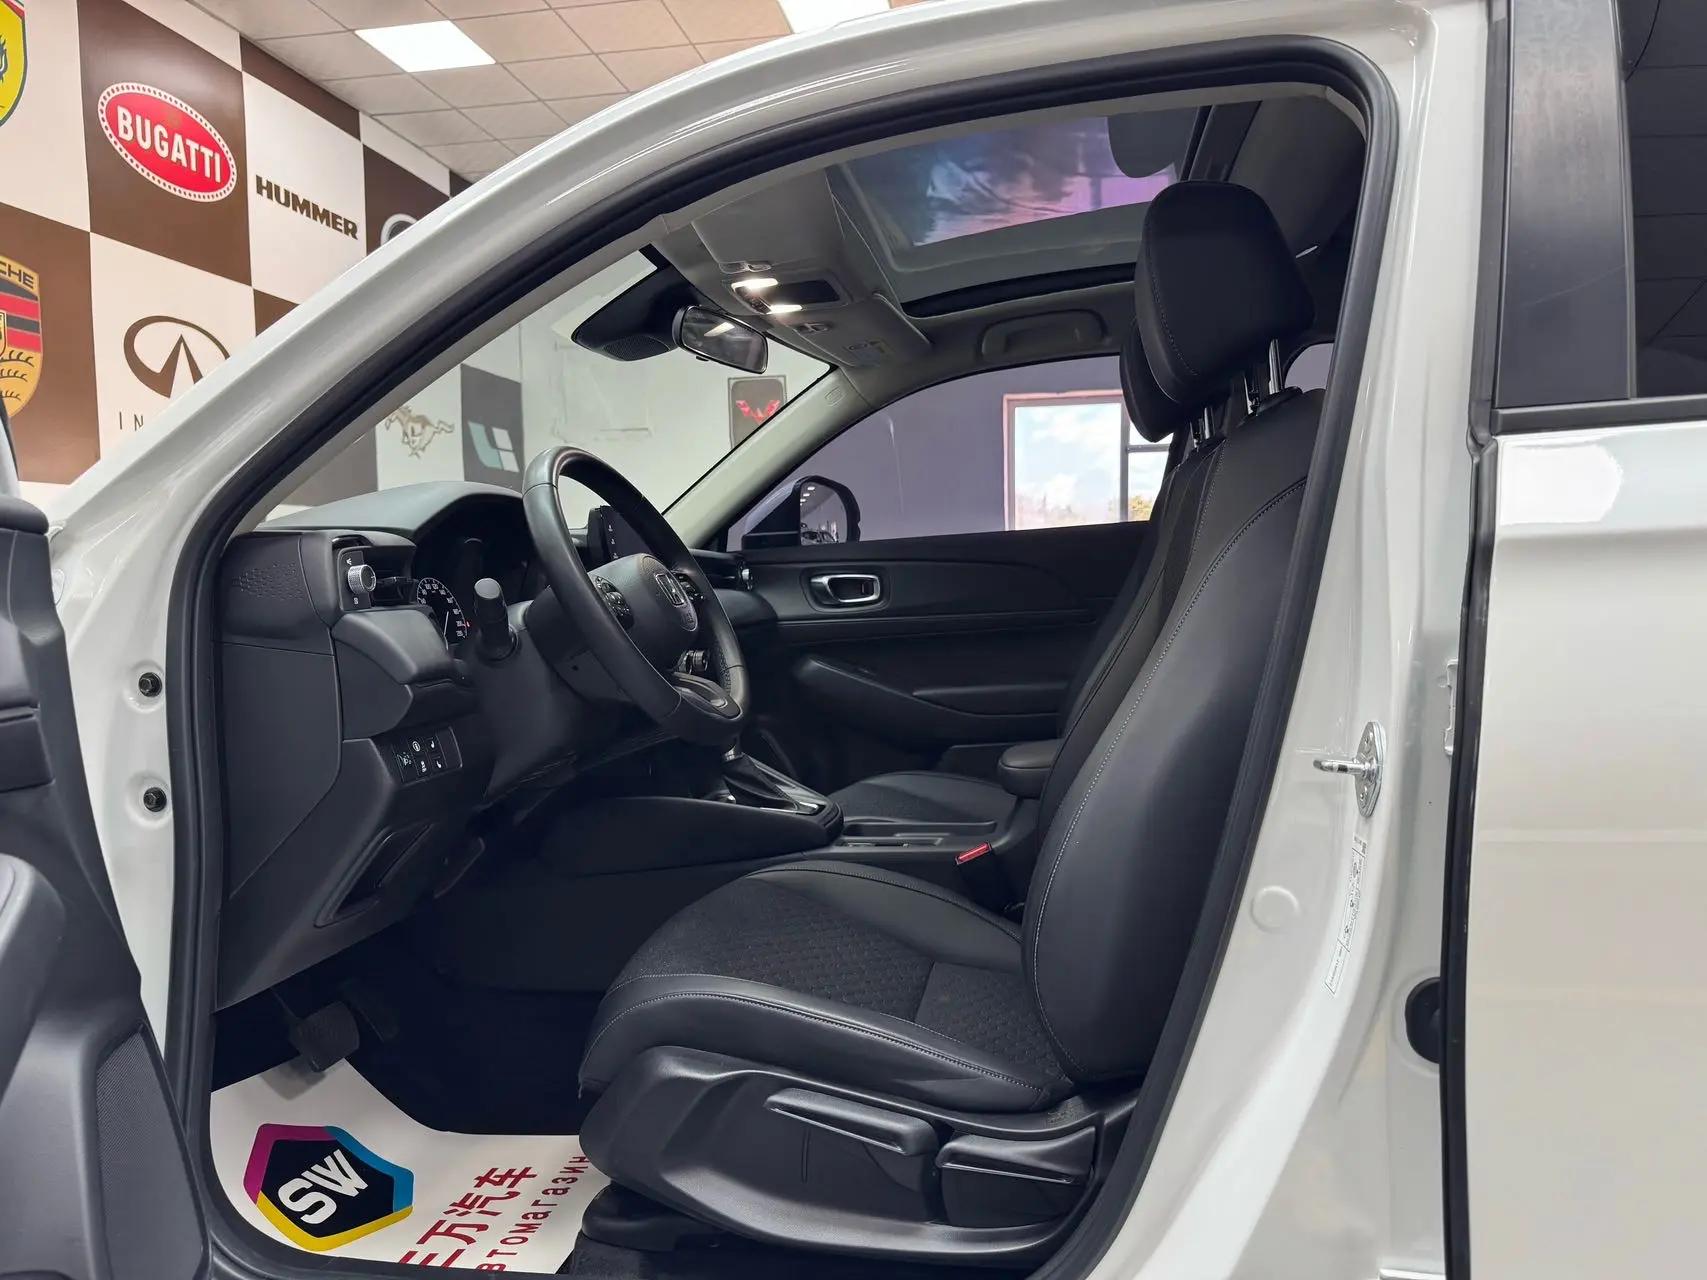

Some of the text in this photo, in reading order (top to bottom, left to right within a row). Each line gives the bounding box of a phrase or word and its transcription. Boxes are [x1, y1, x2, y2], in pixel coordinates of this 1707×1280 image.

[116, 105, 222, 183] BUGATTI
[255, 174, 359, 240] HUMMER
[278, 1149, 369, 1225] SW
